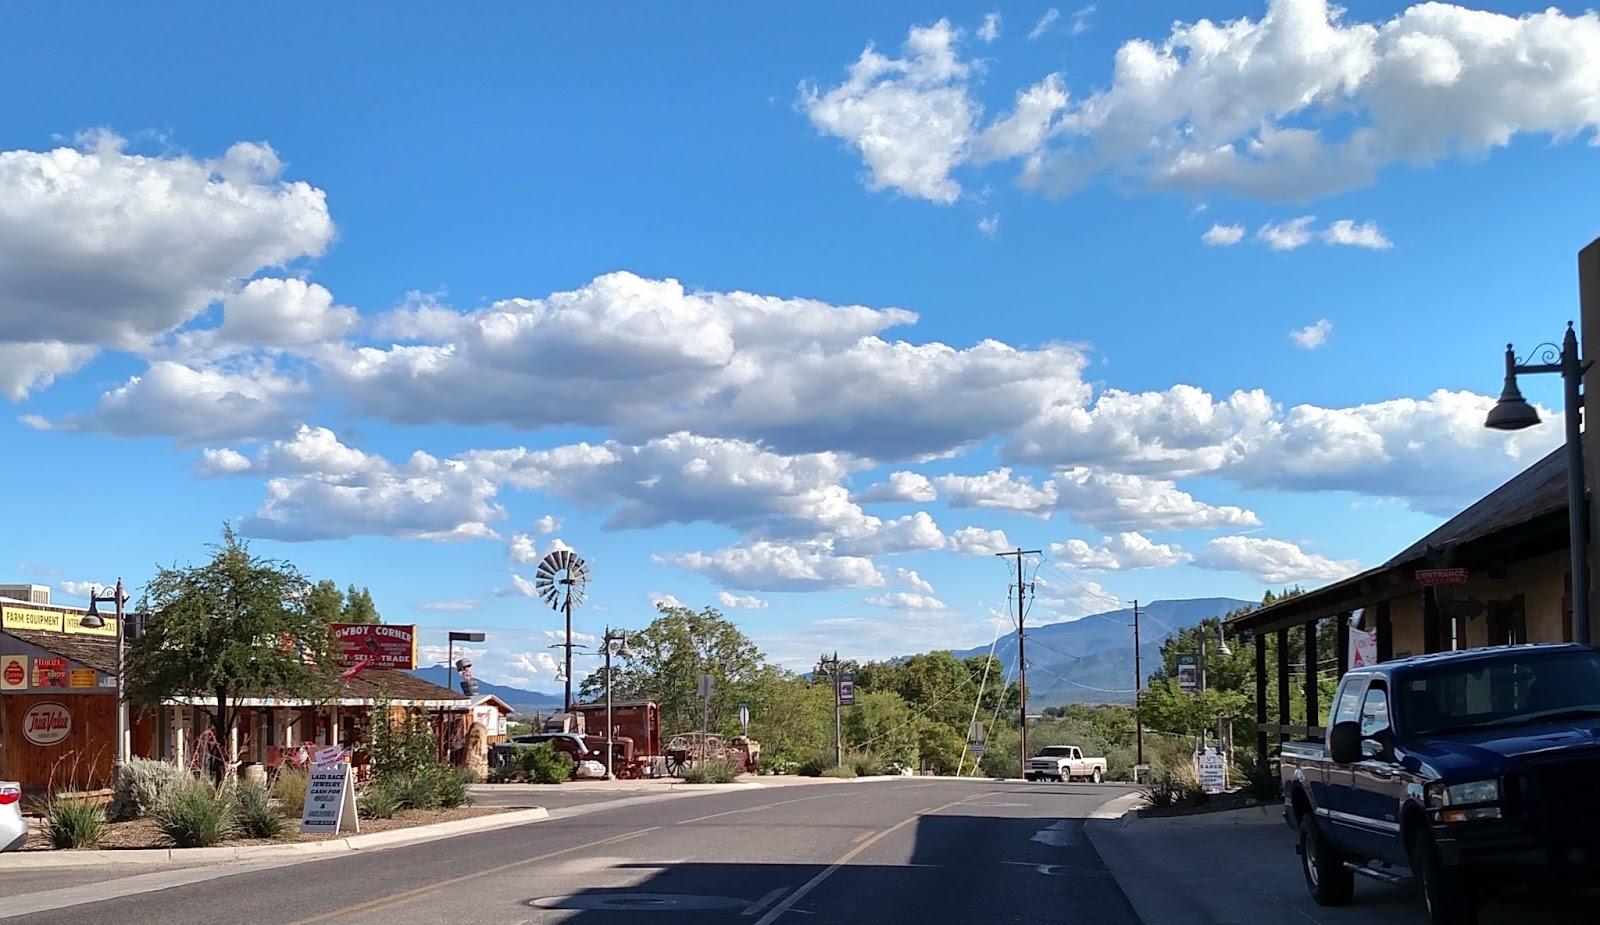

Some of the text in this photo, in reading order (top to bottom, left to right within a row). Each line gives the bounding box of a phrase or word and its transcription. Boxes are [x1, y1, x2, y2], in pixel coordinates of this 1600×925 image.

[6, 611, 25, 623] FARM
[26, 613, 60, 627] EQUIPMENT
[335, 626, 412, 642] OWBOY CORNER
[354, 654, 375, 662] SELL
[29, 711, 69, 732] True Value
